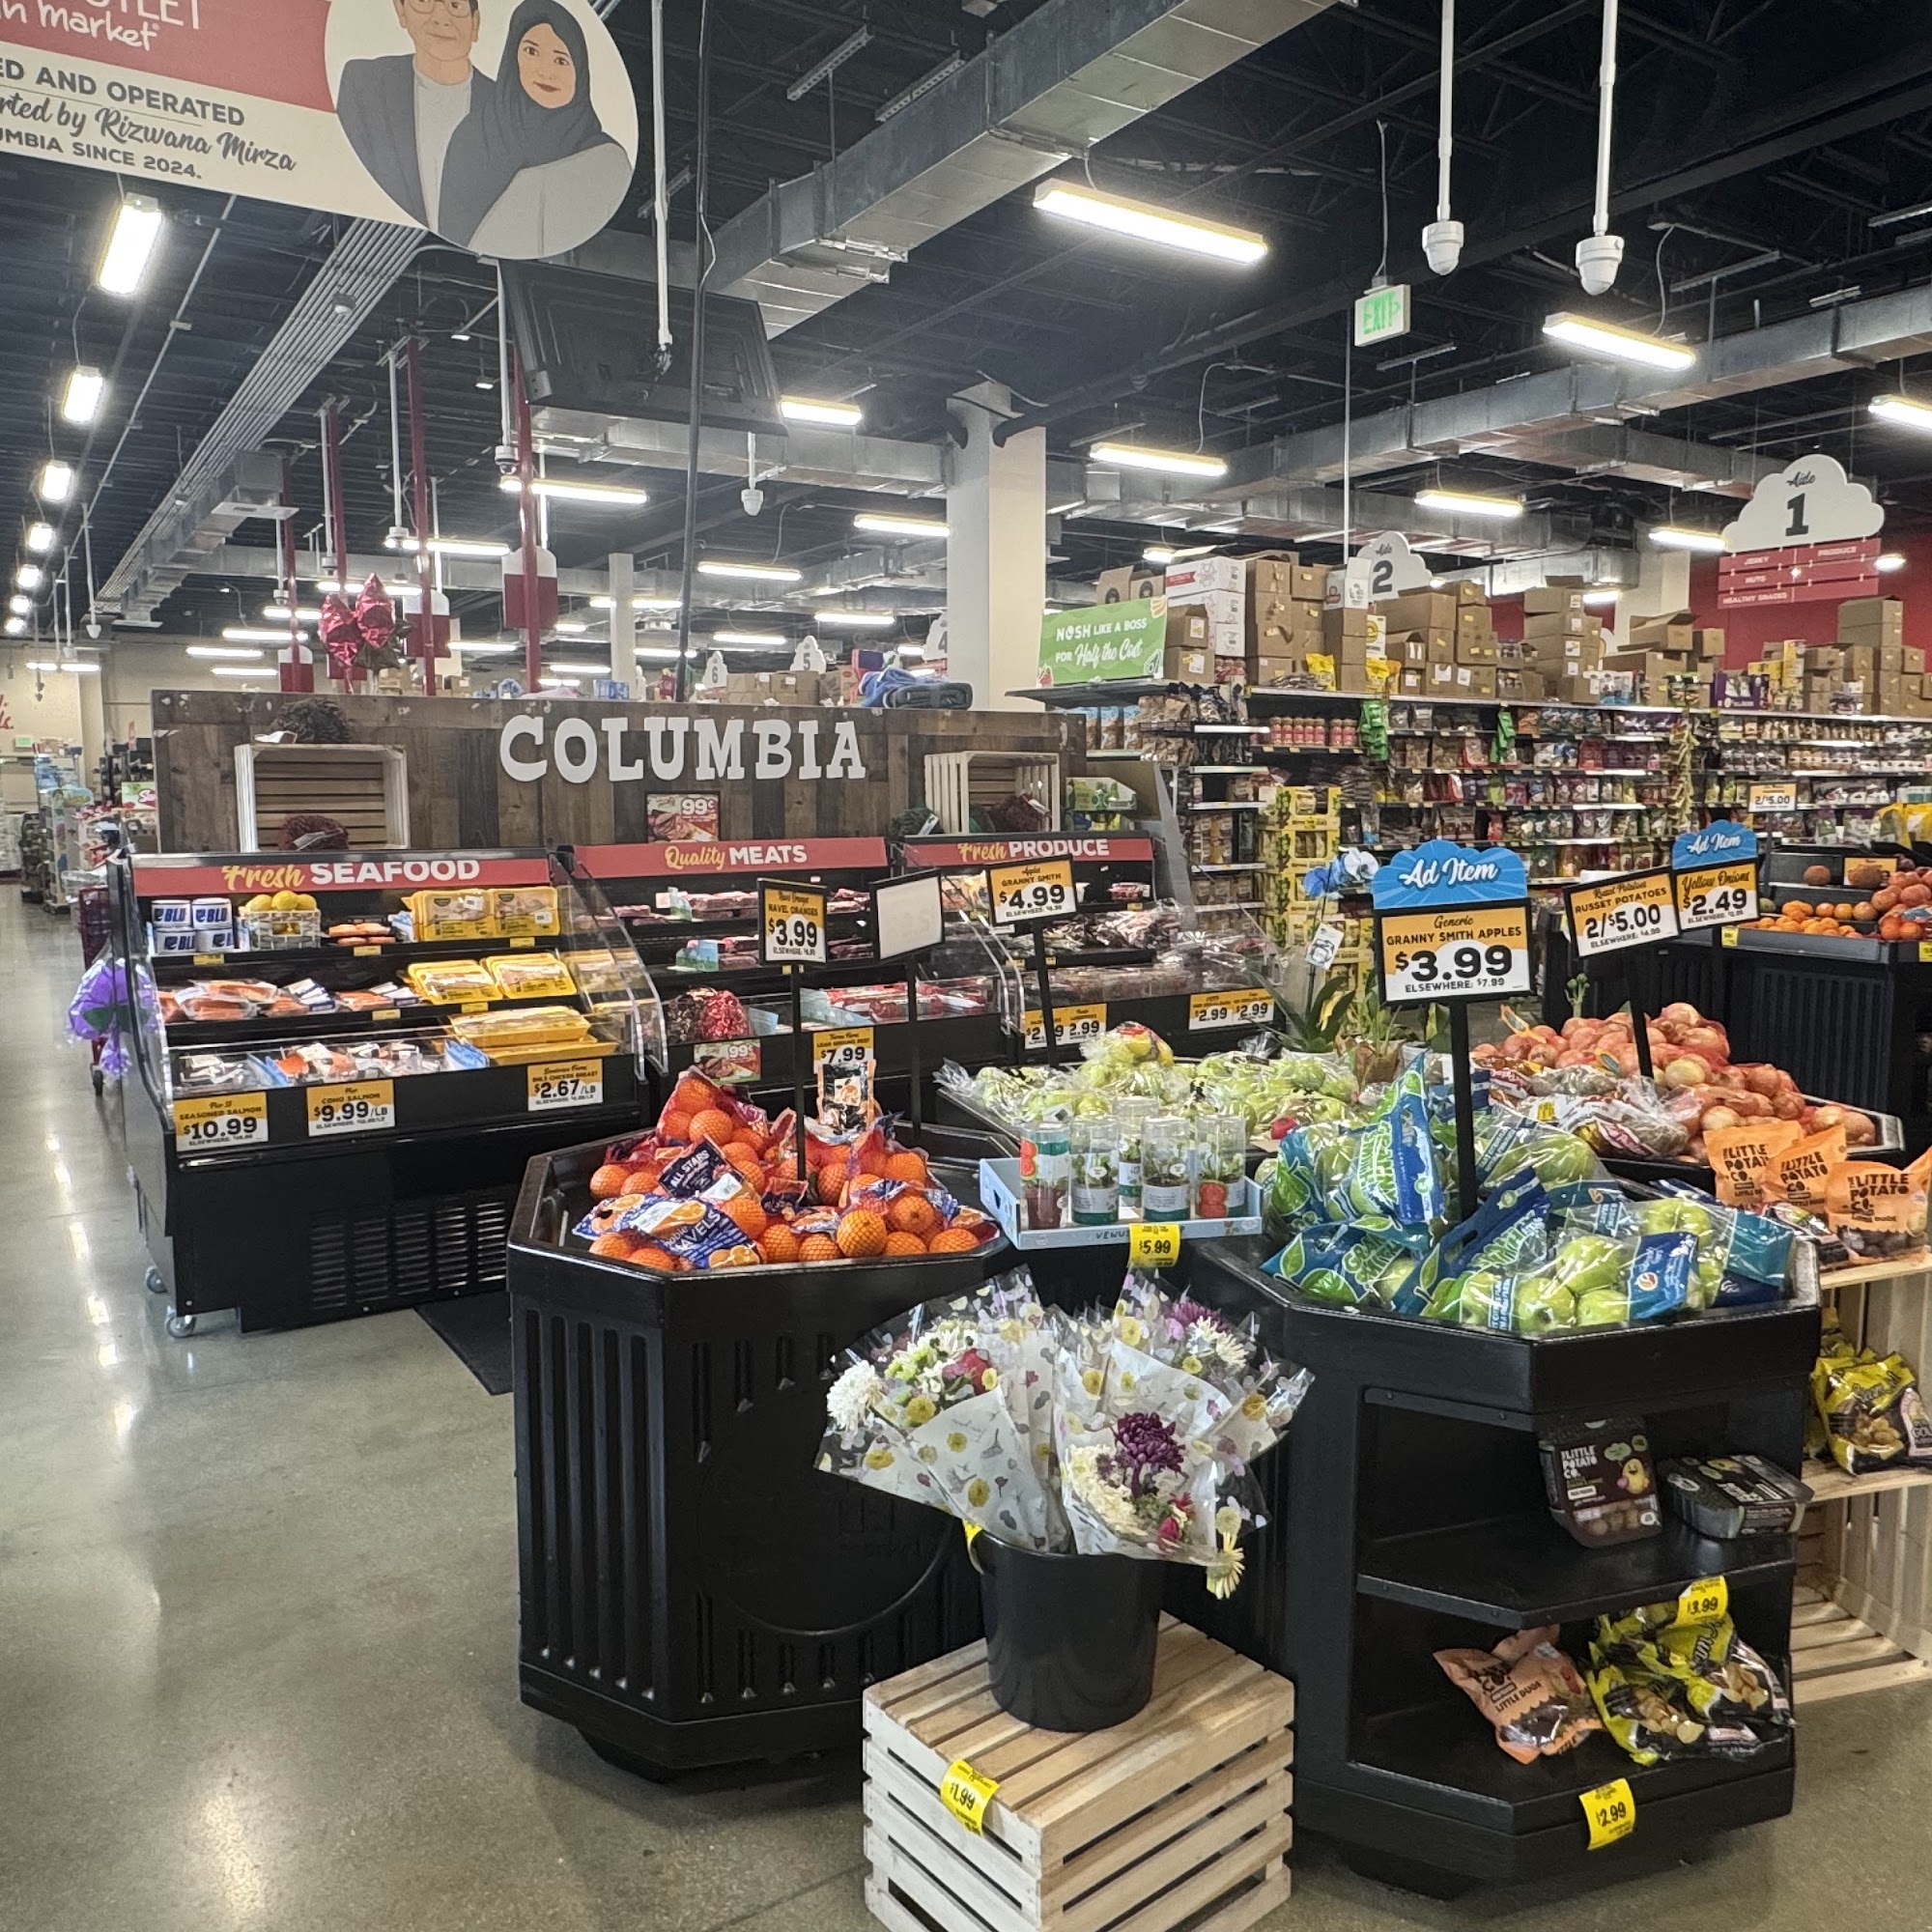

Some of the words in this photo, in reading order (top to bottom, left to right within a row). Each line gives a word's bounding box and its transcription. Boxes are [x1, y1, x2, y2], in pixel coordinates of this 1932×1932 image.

[38, 0, 158, 50] market
[86, 0, 199, 30] LET
[0, 59, 24, 80] D
[36, 67, 97, 95] AND
[106, 81, 245, 126] OPERATED
[57, 100, 87, 137] by
[94, 107, 213, 155] Rizwana
[215, 131, 297, 171] Mirza
[0, 128, 64, 154] MBIA
[72, 142, 135, 166] SINCE
[143, 156, 202, 179] 2024.
[1364, 292, 1395, 334] EXIT
[1785, 493, 1809, 536] 1
[1744, 555, 1770, 565] JERKY
[1817, 546, 1857, 556] PRODUCE
[1373, 560, 1393, 594] 2
[1745, 575, 1766, 583] NUTS
[1722, 594, 1756, 605] HEALTHY
[1758, 592, 1787, 601] SNACKS
[1056, 624, 1092, 641] NOSH
[1094, 623, 1112, 636] LIKE
[1114, 622, 1122, 633] A
[1123, 617, 1148, 631] BOSS
[803, 653, 811, 671] 5
[1055, 651, 1073, 663] FOR
[1074, 643, 1101, 668] Half
[1101, 641, 1118, 661] the
[712, 667, 718, 683] 6
[498, 714, 867, 783] COLUMBIA
[957, 842, 1008, 863] Fresh
[1008, 838, 1110, 859] PRODUCE
[1687, 835, 1710, 855] Ad
[1711, 833, 1743, 852] Item
[665, 845, 726, 870] Quality
[729, 844, 808, 866] MEATS
[220, 864, 305, 892] Fresh
[310, 860, 480, 886] SEAFOOD
[1002, 877, 1035, 887] GRANNY
[1037, 873, 1062, 882] SMITH
[1399, 859, 1440, 889] Ad
[1441, 857, 1498, 886] Item
[1682, 874, 1716, 895] Yellow
[1718, 870, 1750, 885] Onions
[999, 884, 1065, 909] $4.99
[1575, 899, 1612, 914] RUSSET
[1614, 888, 1667, 905] POTATOES
[1683, 888, 1747, 916] $2.49
[768, 903, 789, 914] NAVEL
[790, 906, 818, 917] ORANGES
[1585, 903, 1662, 939] 2/$5.00
[768, 917, 817, 948] $3.99
[1434, 916, 1474, 929] Generic
[1386, 933, 1435, 946] GRANNY
[1438, 929, 1474, 942] SMITH
[1478, 926, 1522, 940] APPLES
[1395, 945, 1513, 982] $3.99
[1477, 978, 1505, 987] $7.99
[821, 1046, 866, 1064] $7.99
[347, 1093, 381, 1101] SALMON
[180, 1110, 224, 1120] SEASONED
[184, 1117, 257, 1139] $10.99
[1728, 1144, 1768, 1158] LITTLE
[1785, 1151, 1825, 1171] LITTLE
[670, 1172, 685, 1187] ALL
[681, 1150, 710, 1173] STARS
[1724, 1156, 1770, 1171] POTA
[1780, 1164, 1829, 1184] POTATO
[1856, 1173, 1910, 1187] LITTLE
[1850, 1185, 1910, 1202] POTATO
[1851, 1198, 1874, 1210] CO.
[1139, 1239, 1172, 1255] $5.99
[1563, 1455, 1598, 1469] POTATO
[1565, 1445, 1596, 1460] LITTLE
[1494, 1694, 1520, 1713] LITTLE
[1595, 1801, 1627, 1828] $2.99
